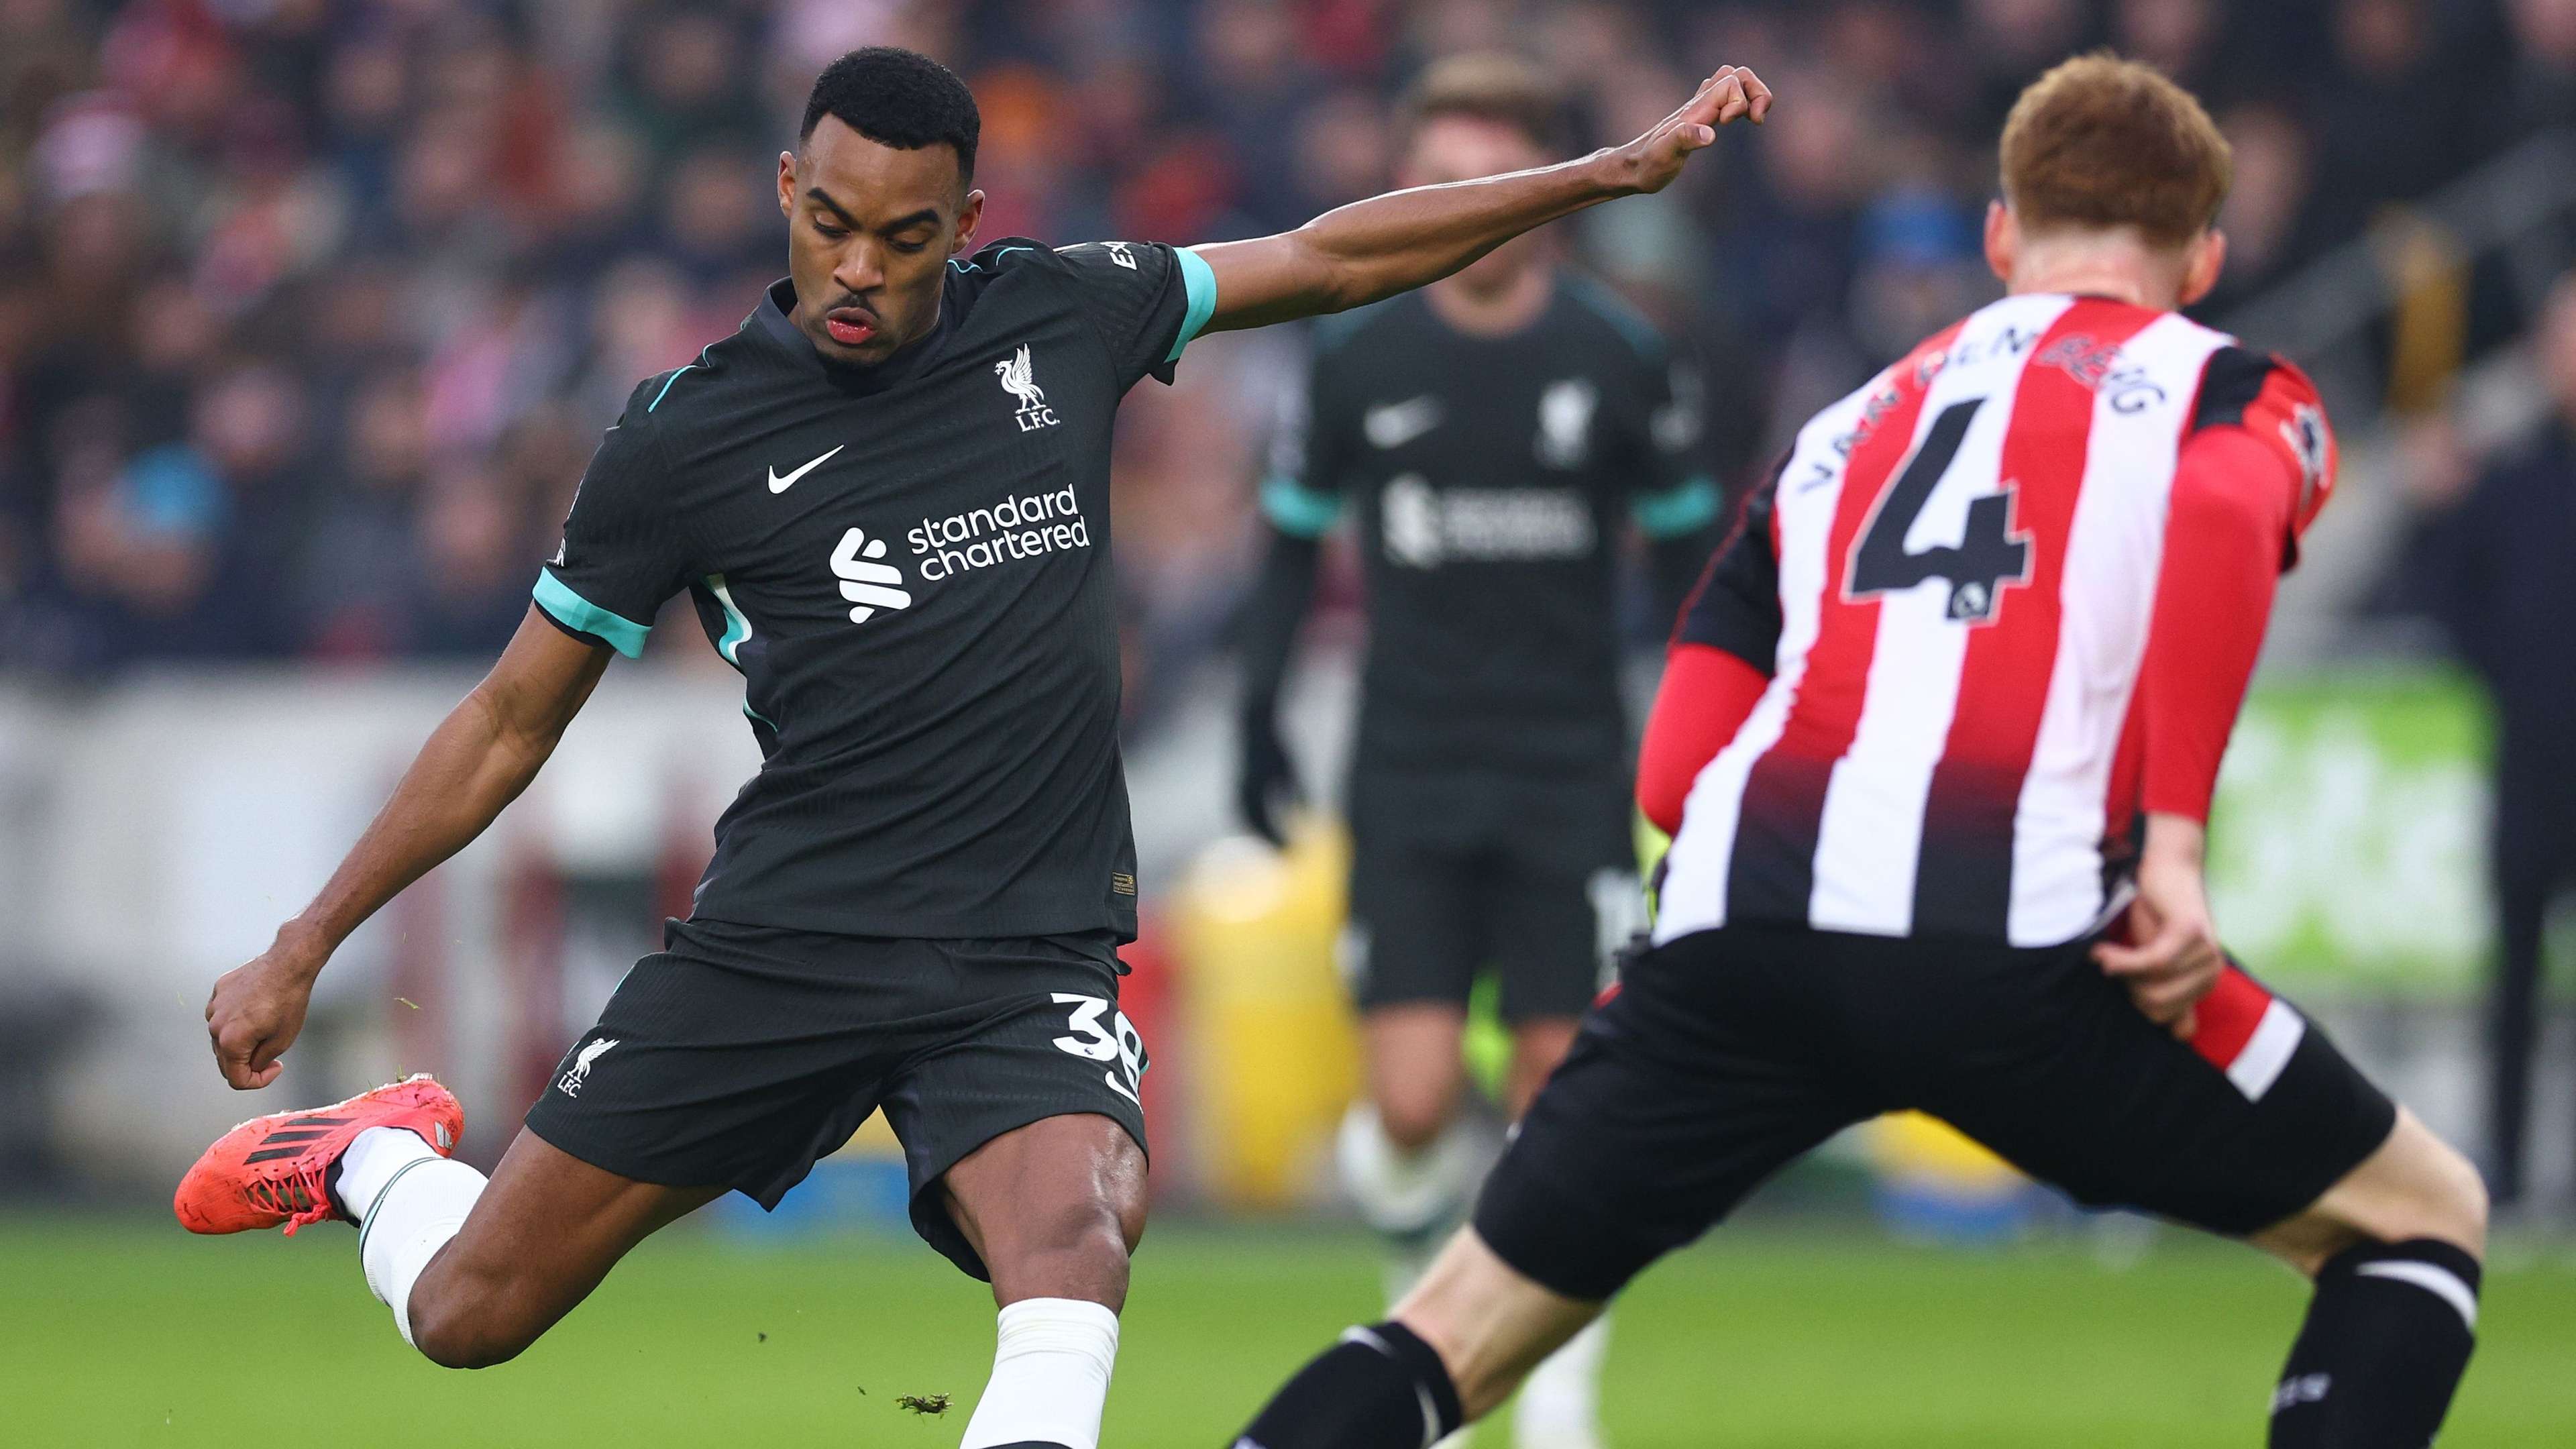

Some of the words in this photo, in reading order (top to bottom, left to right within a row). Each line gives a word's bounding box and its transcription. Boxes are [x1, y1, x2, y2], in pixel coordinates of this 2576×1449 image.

[1015, 408, 1061, 433] L.F.C.
[1798, 384, 1901, 495] VAN
[1917, 324, 2043, 388] DEN
[907, 482, 1079, 555] standard
[1840, 394, 2035, 623] 4
[919, 515, 1091, 582] chartered
